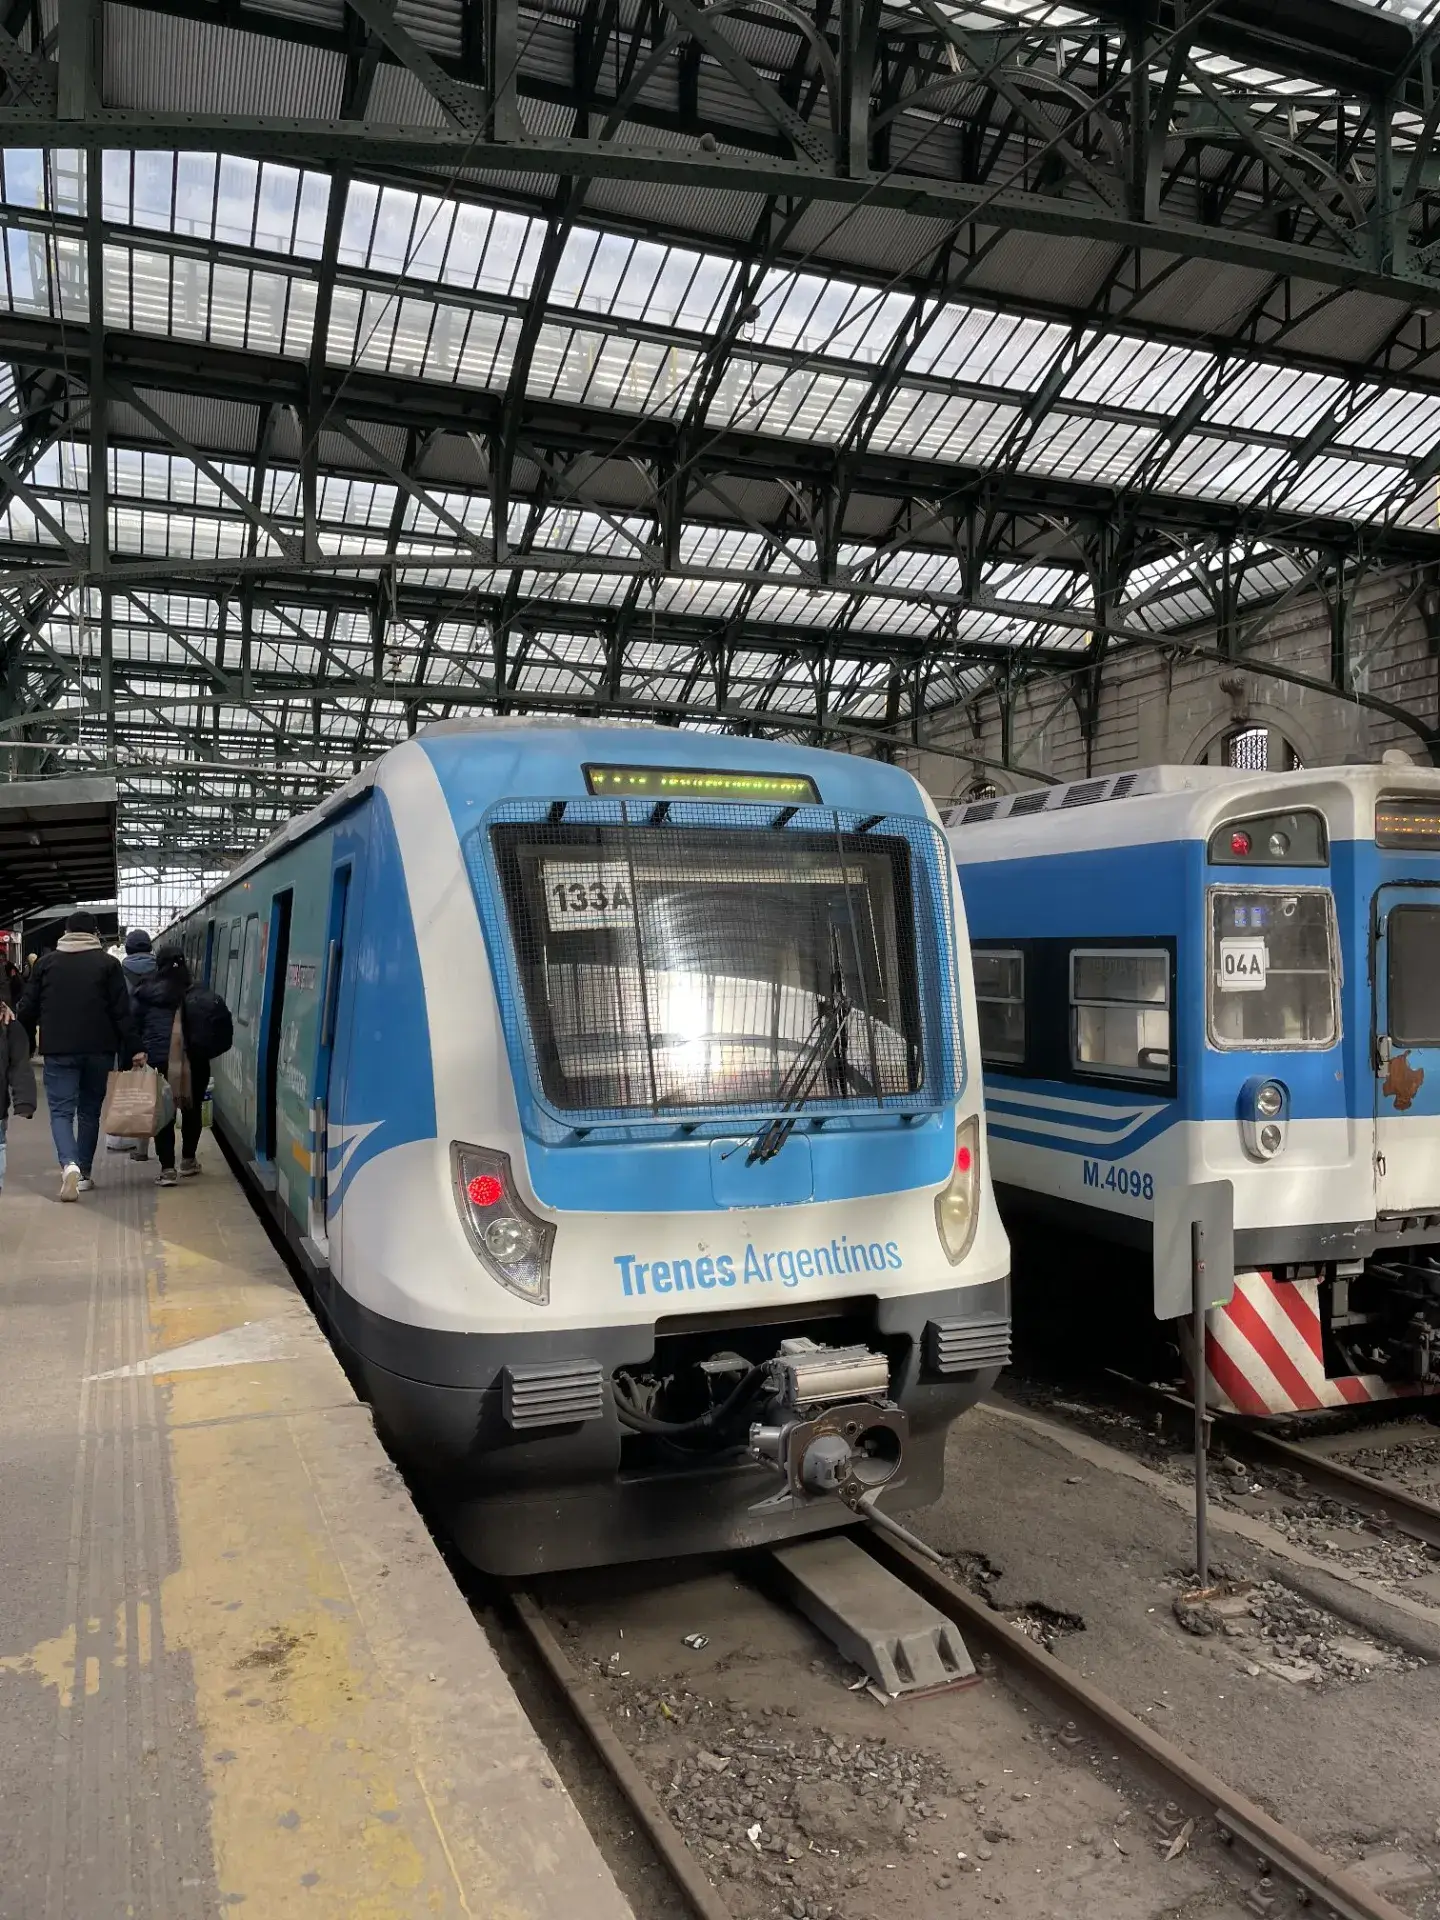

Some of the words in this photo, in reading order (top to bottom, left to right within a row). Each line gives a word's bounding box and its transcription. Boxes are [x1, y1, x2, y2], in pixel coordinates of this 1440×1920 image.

[552, 882, 631, 912] 133A
[1225, 953, 1262, 975] 04A
[1083, 1160, 1154, 1200] M.4098
[613, 1254, 737, 1297] Trenes
[743, 1235, 903, 1288] Argentinos
